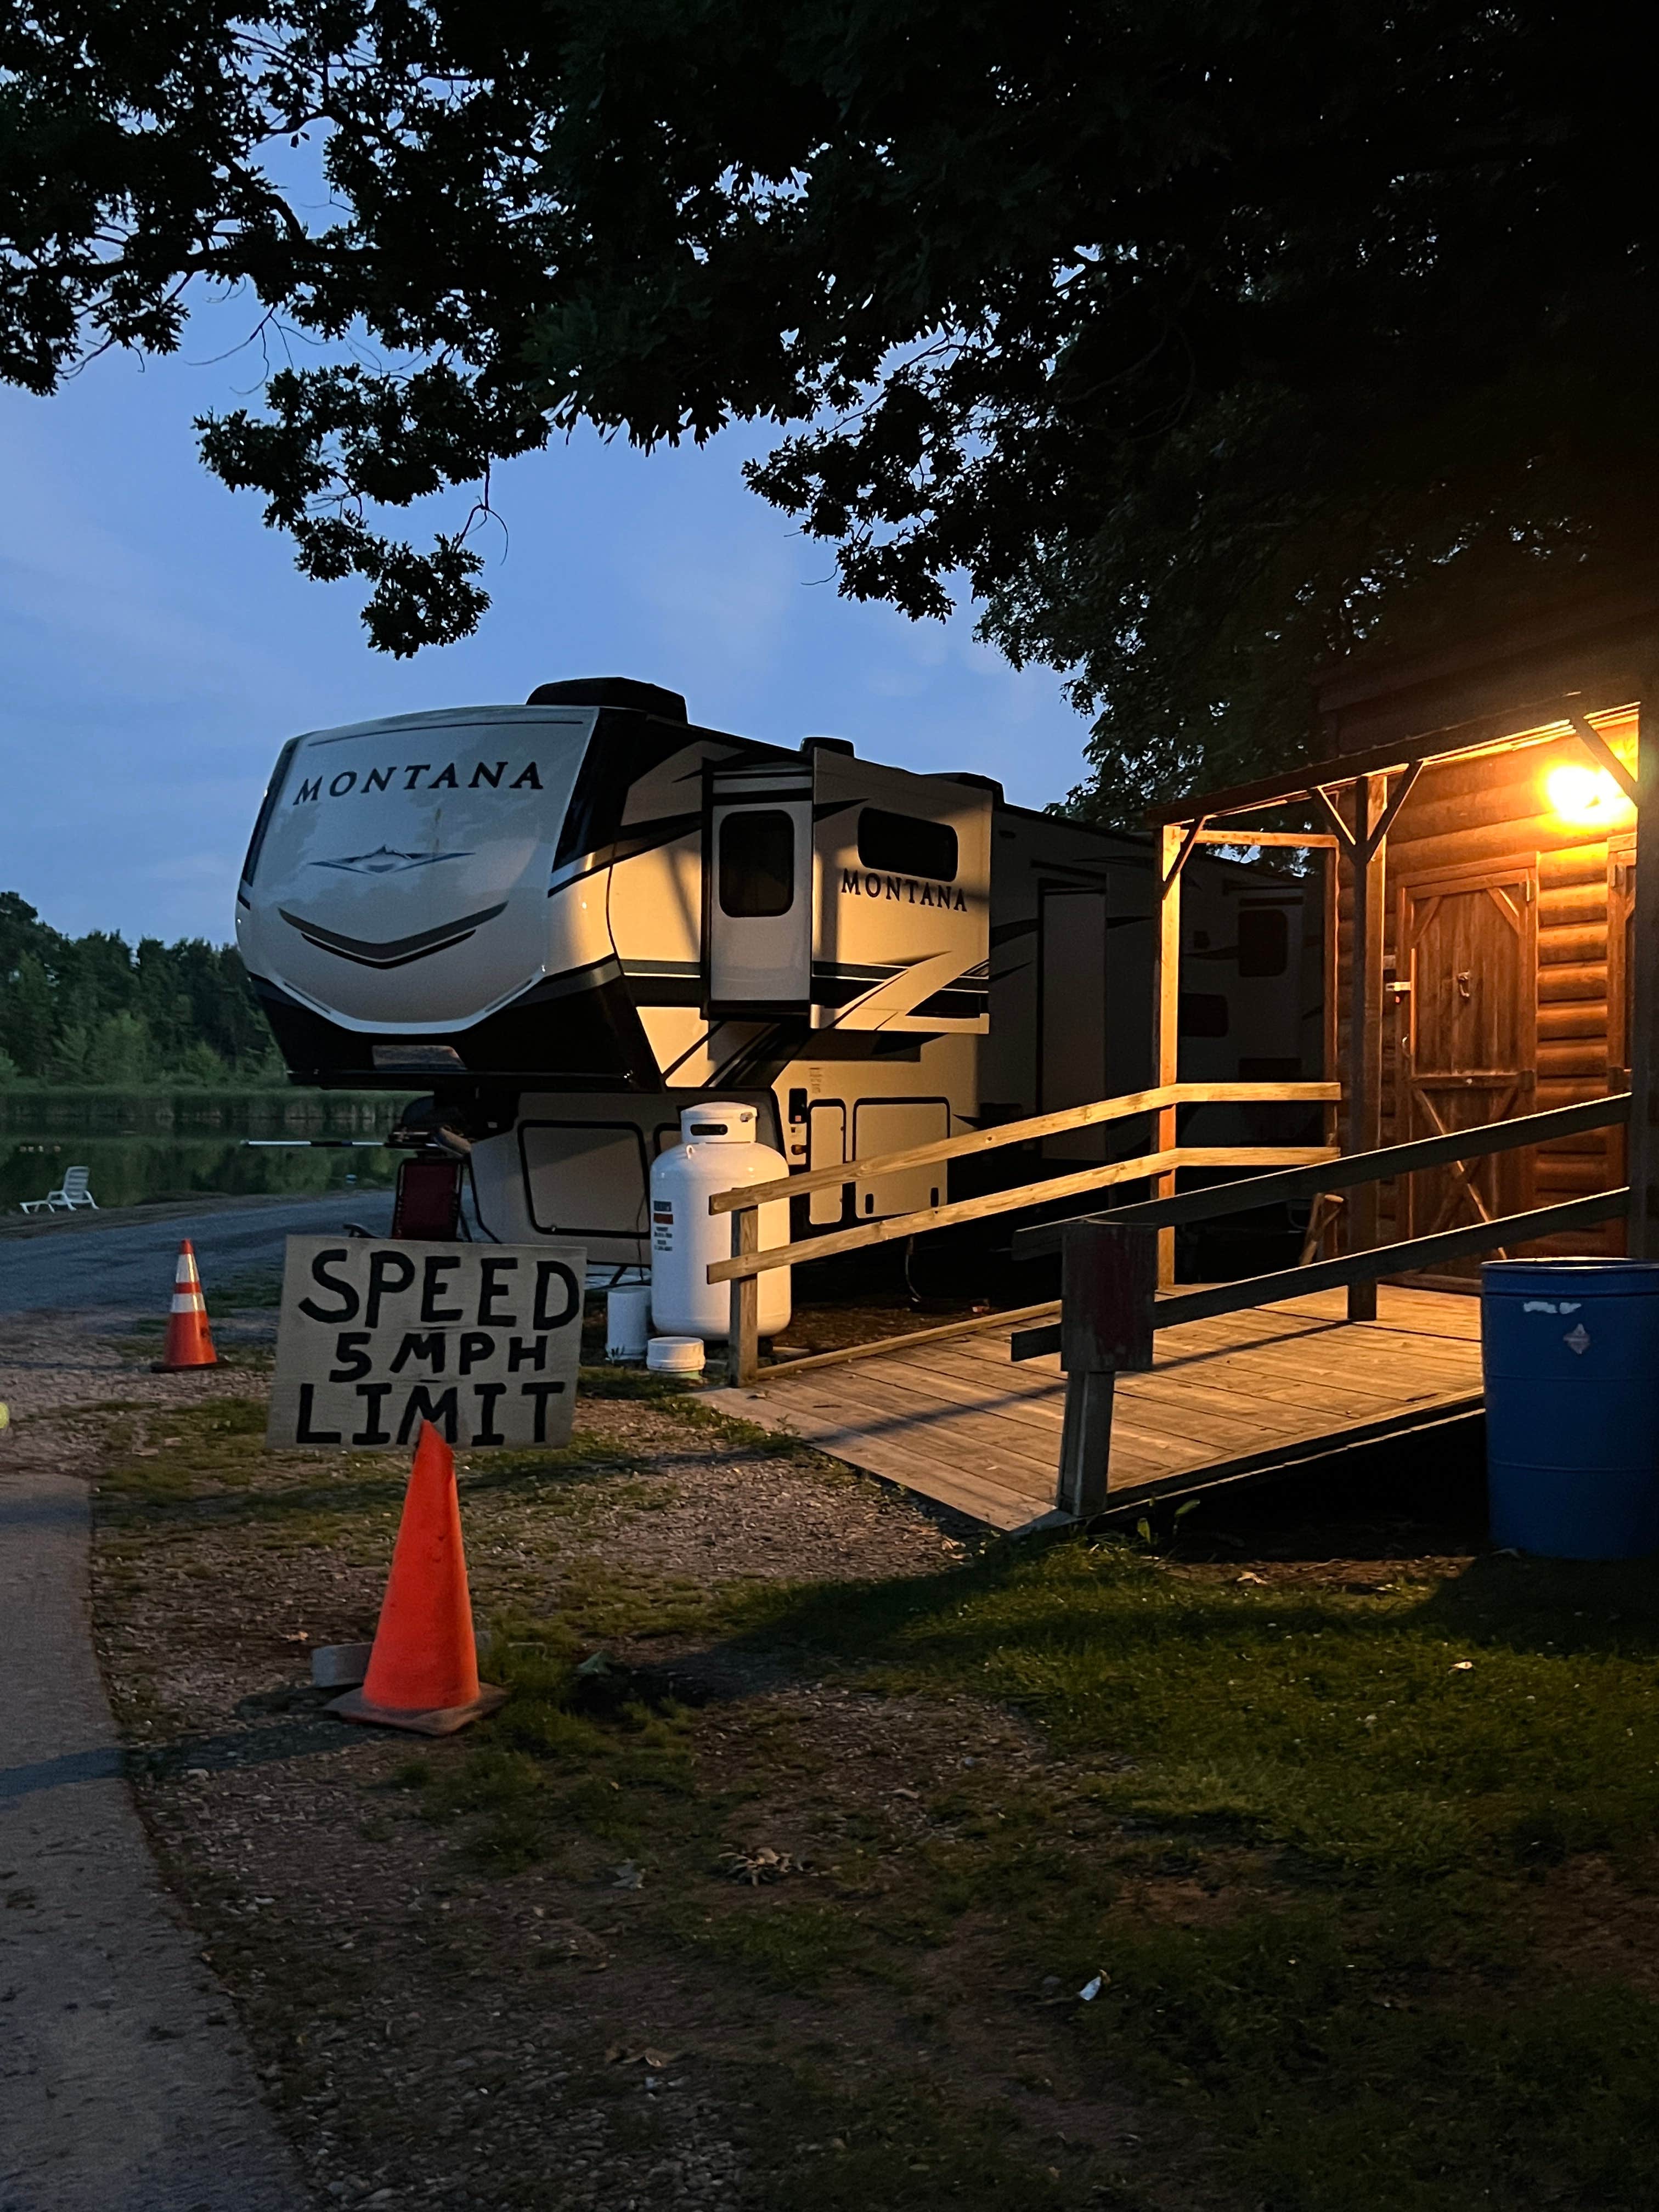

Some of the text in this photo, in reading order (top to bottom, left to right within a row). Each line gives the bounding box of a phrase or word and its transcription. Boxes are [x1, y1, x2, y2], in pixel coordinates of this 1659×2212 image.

[292, 761, 544, 805] MONTANA
[841, 868, 967, 912] MONTANA
[298, 1249, 580, 1330] SPEED
[329, 1331, 548, 1382] 5 MPH
[296, 1381, 565, 1447] LIMIT
